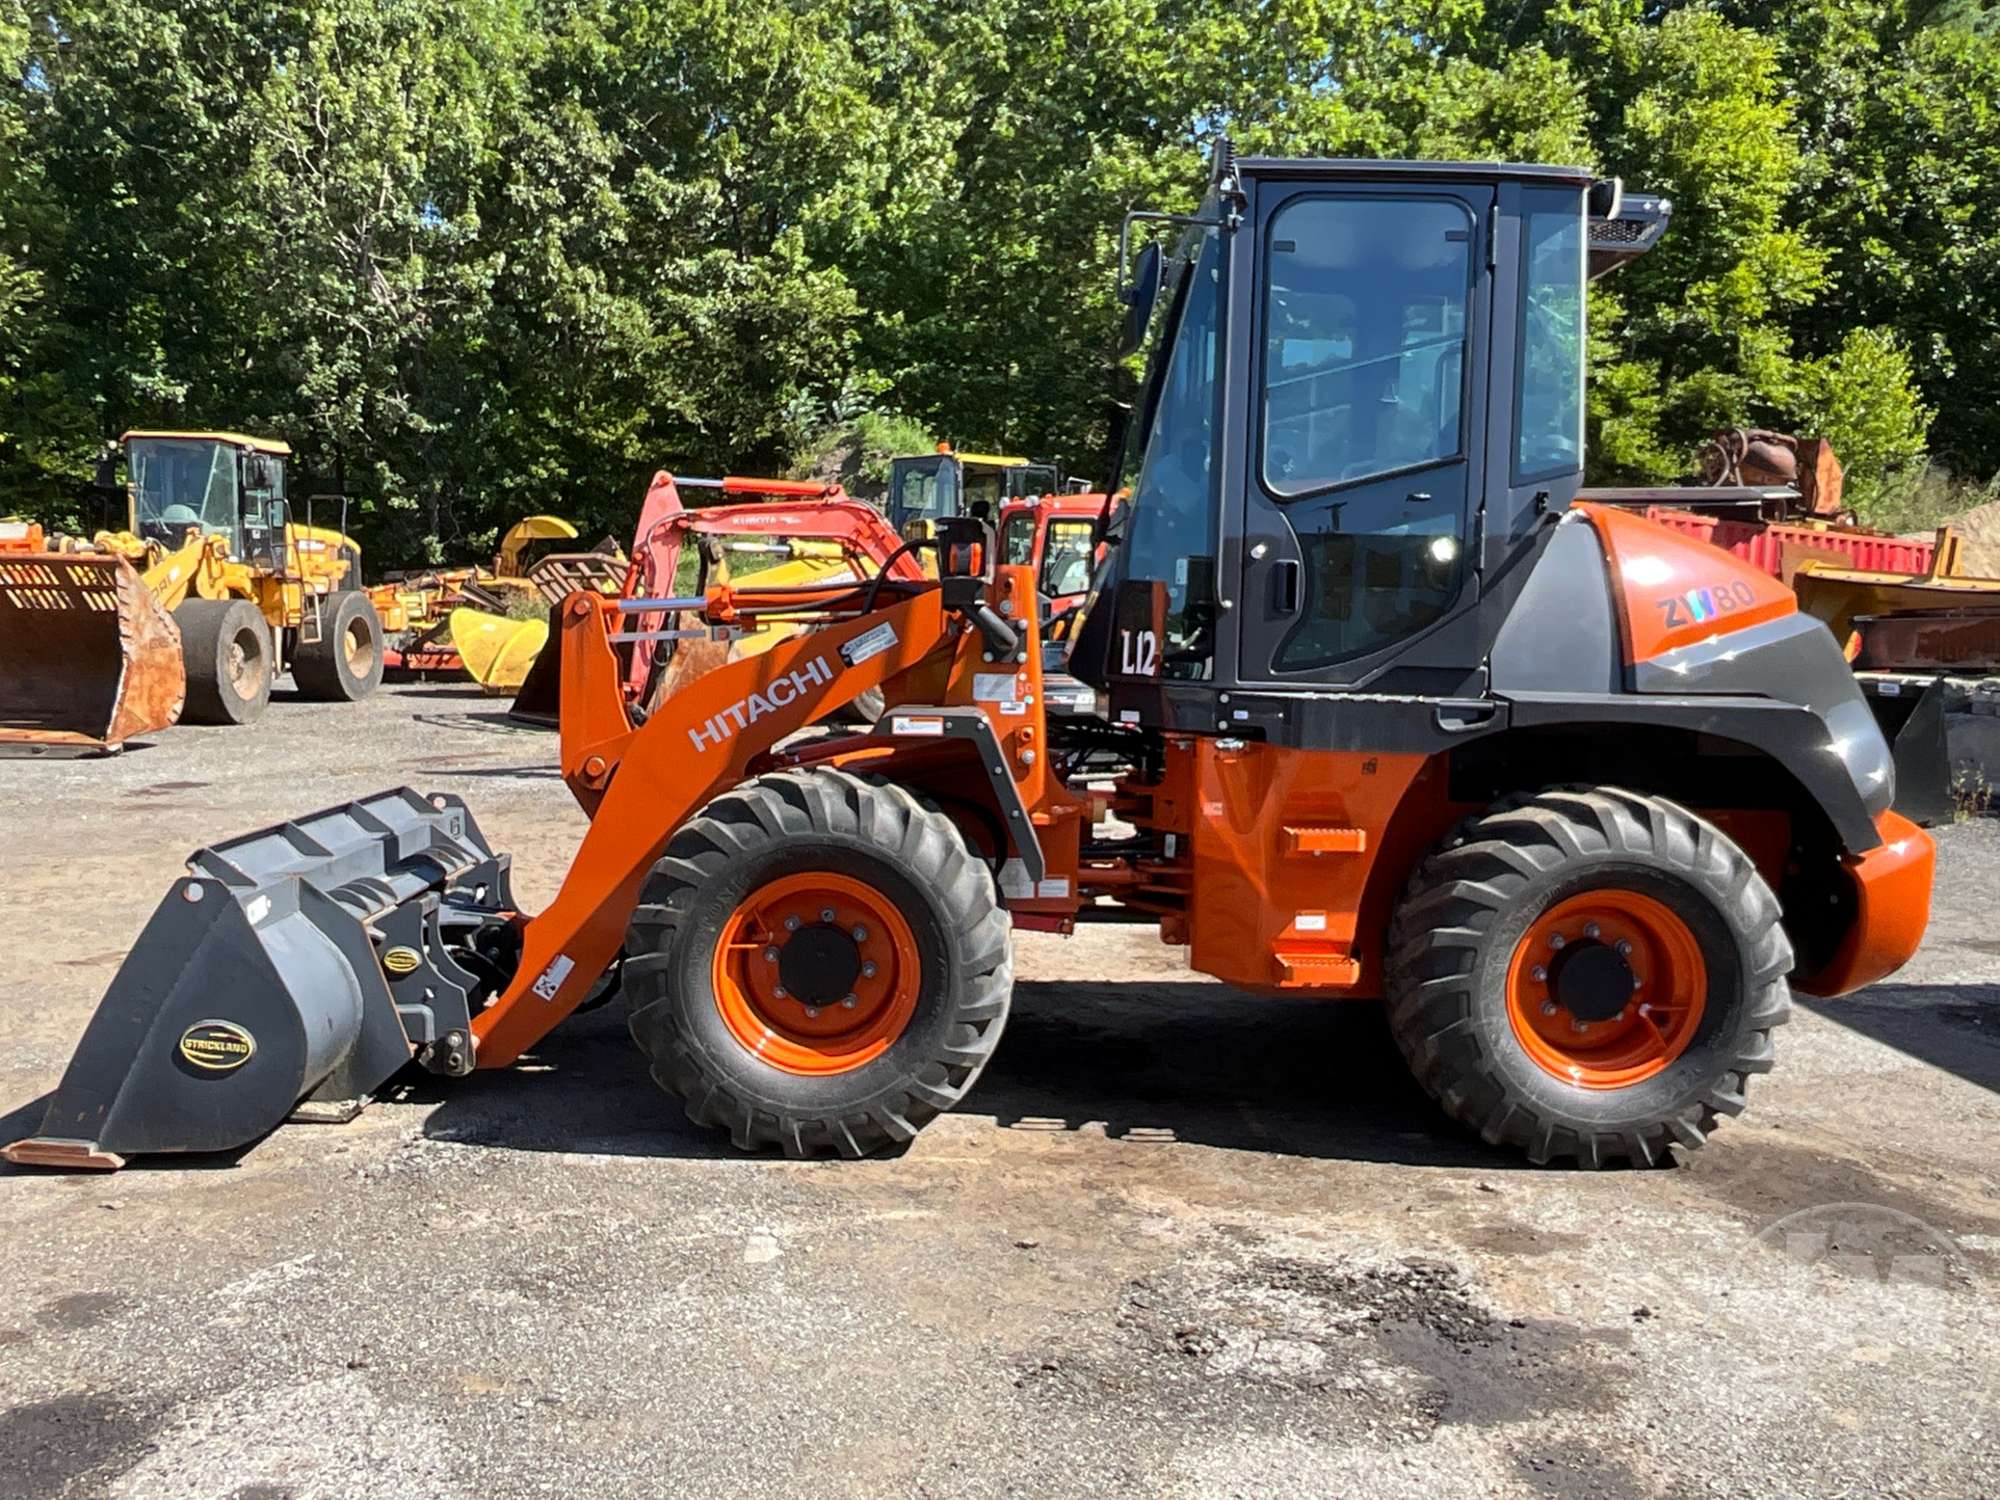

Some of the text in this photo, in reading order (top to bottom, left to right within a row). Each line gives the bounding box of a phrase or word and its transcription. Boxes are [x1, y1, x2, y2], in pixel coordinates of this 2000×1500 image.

[1656, 581, 1755, 629] ZW80
[687, 656, 834, 753] HITACHI
[184, 1038, 248, 1053] STRICKLAND
